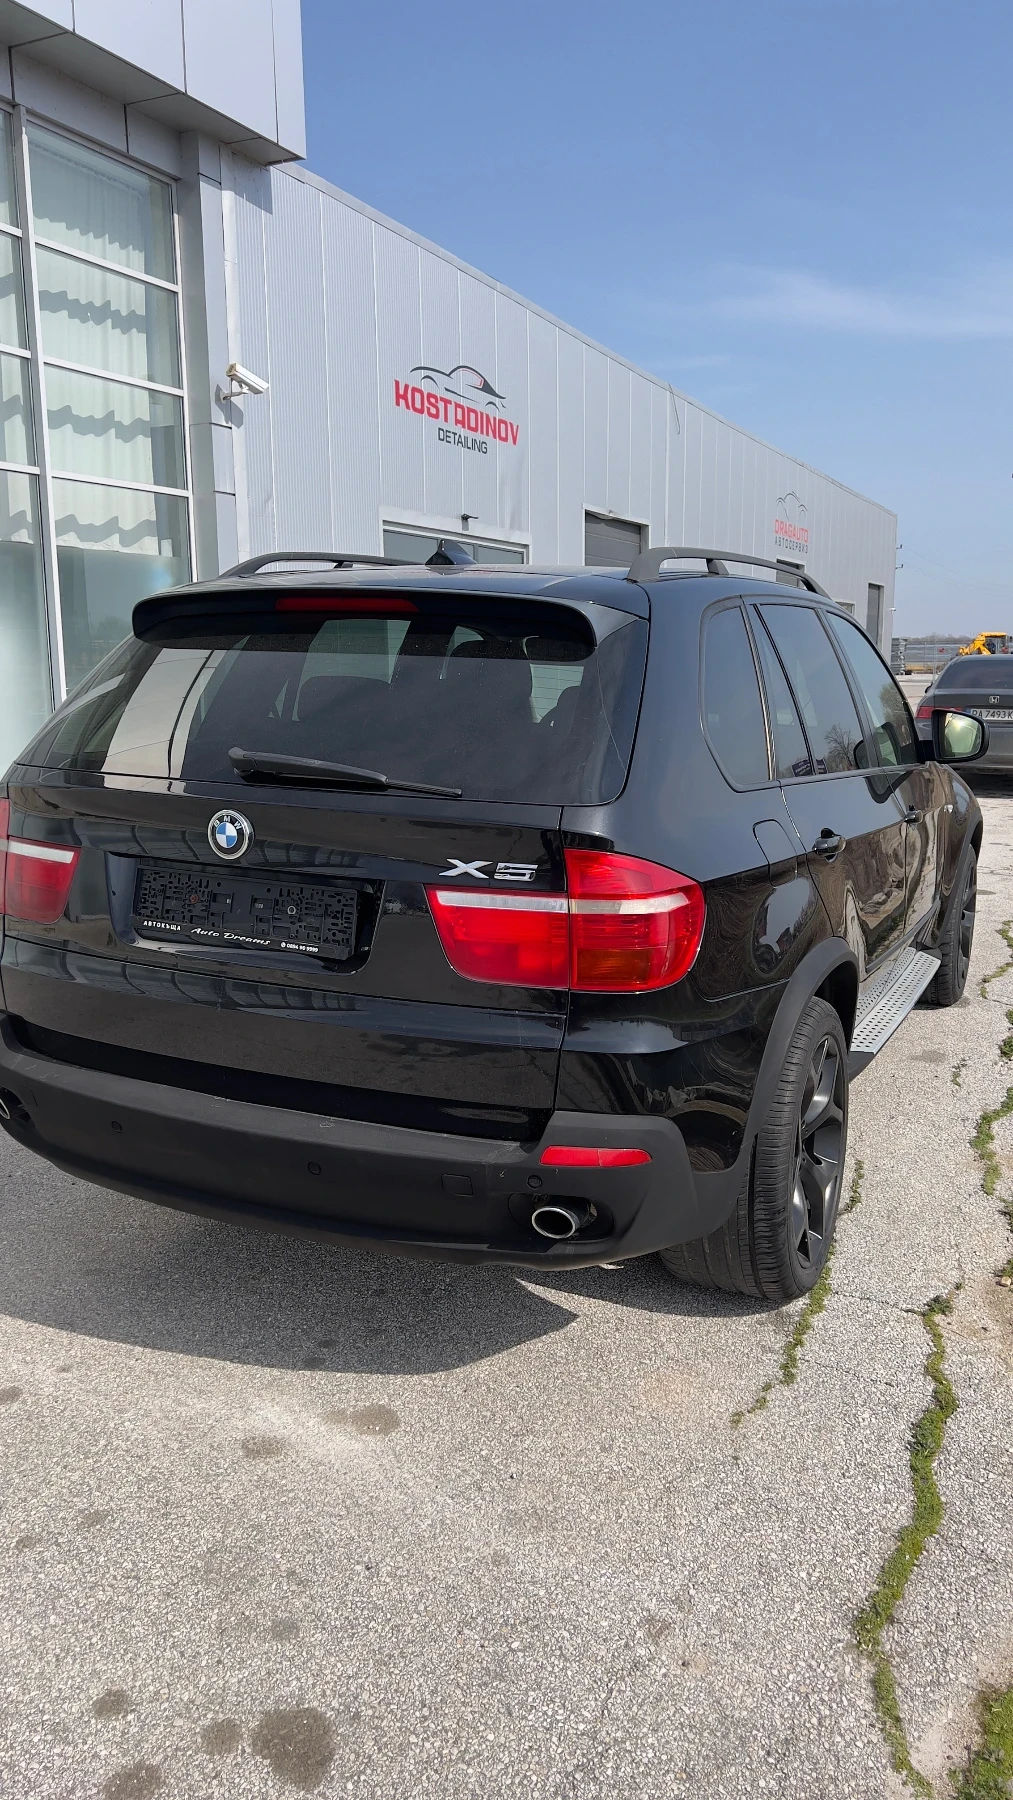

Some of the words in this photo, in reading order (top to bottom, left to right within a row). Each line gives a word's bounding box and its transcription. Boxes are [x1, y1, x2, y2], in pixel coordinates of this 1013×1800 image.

[394, 379, 519, 446] KOSTADINOV
[438, 427, 488, 455] DETAILING
[775, 519, 808, 543] DRAGAUTO
[213, 815, 243, 830] BMW
[438, 858, 539, 882] X5
[143, 920, 181, 931] АВТОКЪЩА
[190, 928, 220, 937] Auto
[223, 932, 271, 945] Dreams
